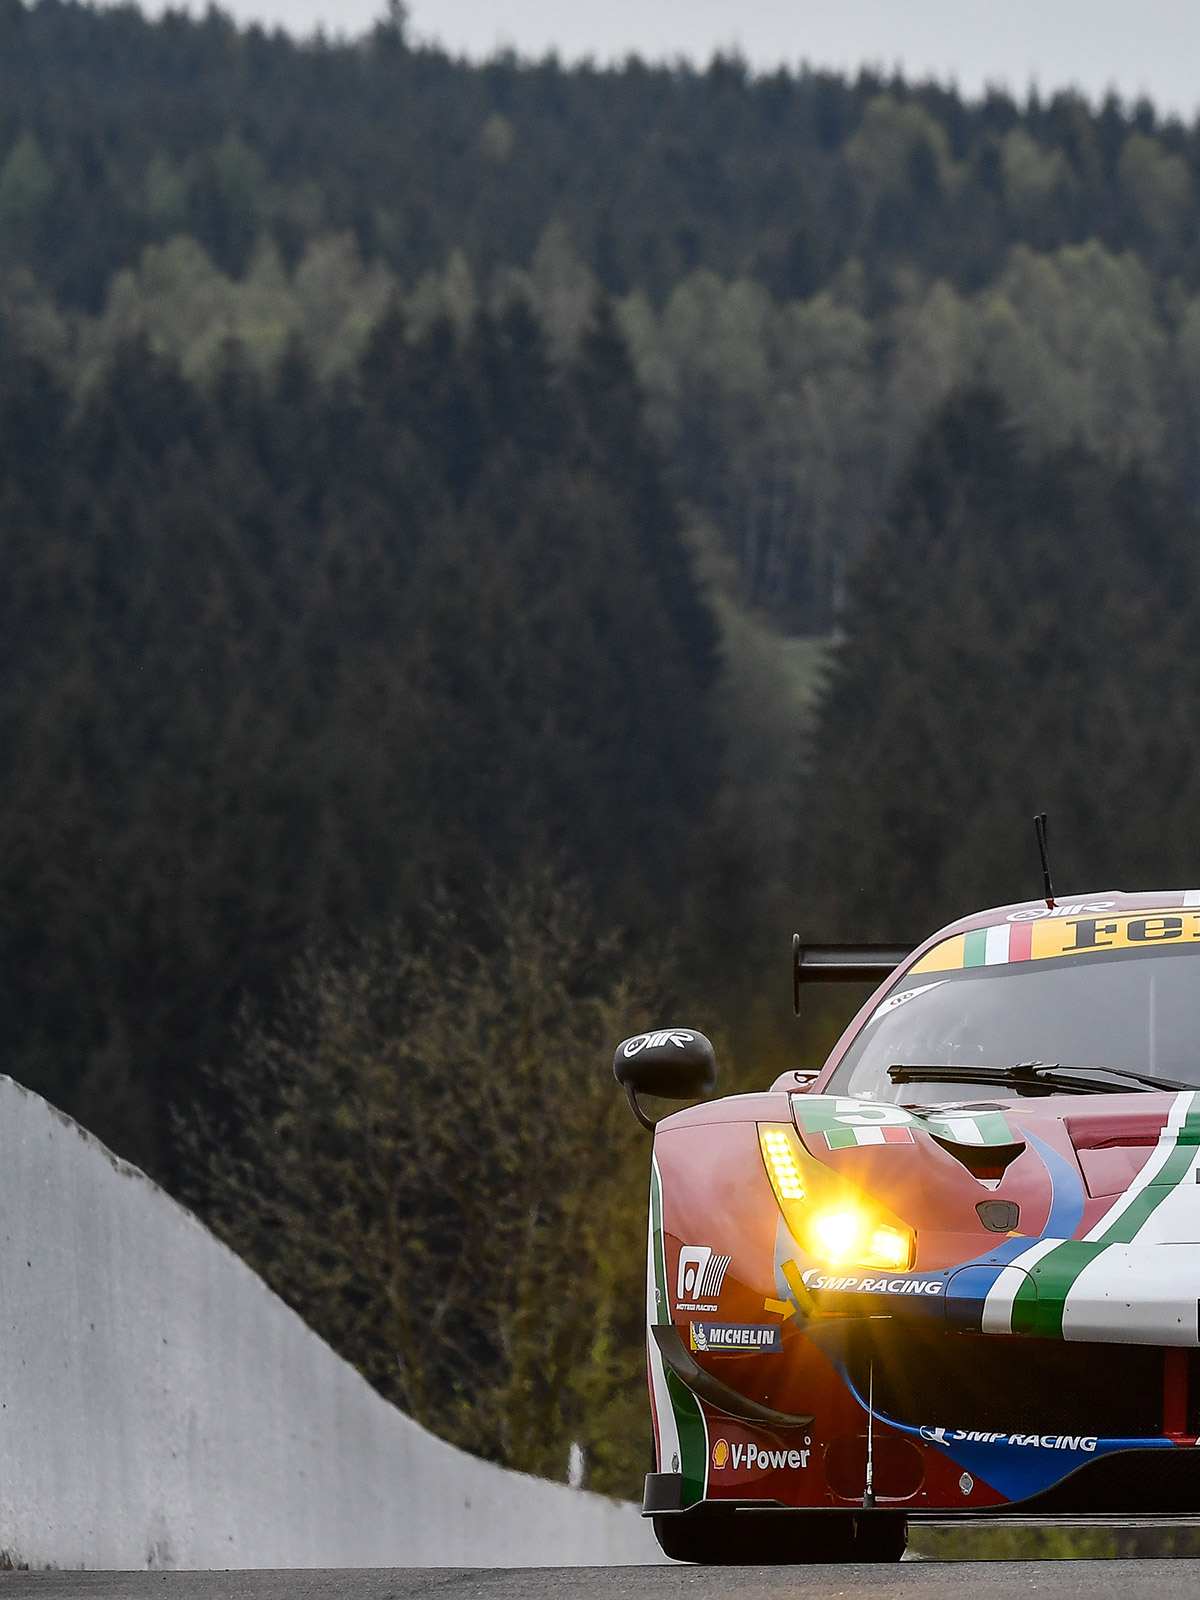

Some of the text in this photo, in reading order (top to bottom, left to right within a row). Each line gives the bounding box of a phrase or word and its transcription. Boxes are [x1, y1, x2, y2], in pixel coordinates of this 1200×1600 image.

[811, 1276, 944, 1294] SMP RACING
[709, 1328, 775, 1345] MICHELIN
[1007, 1434, 1098, 1452] RACING
[731, 1443, 810, 1470] V-Power
